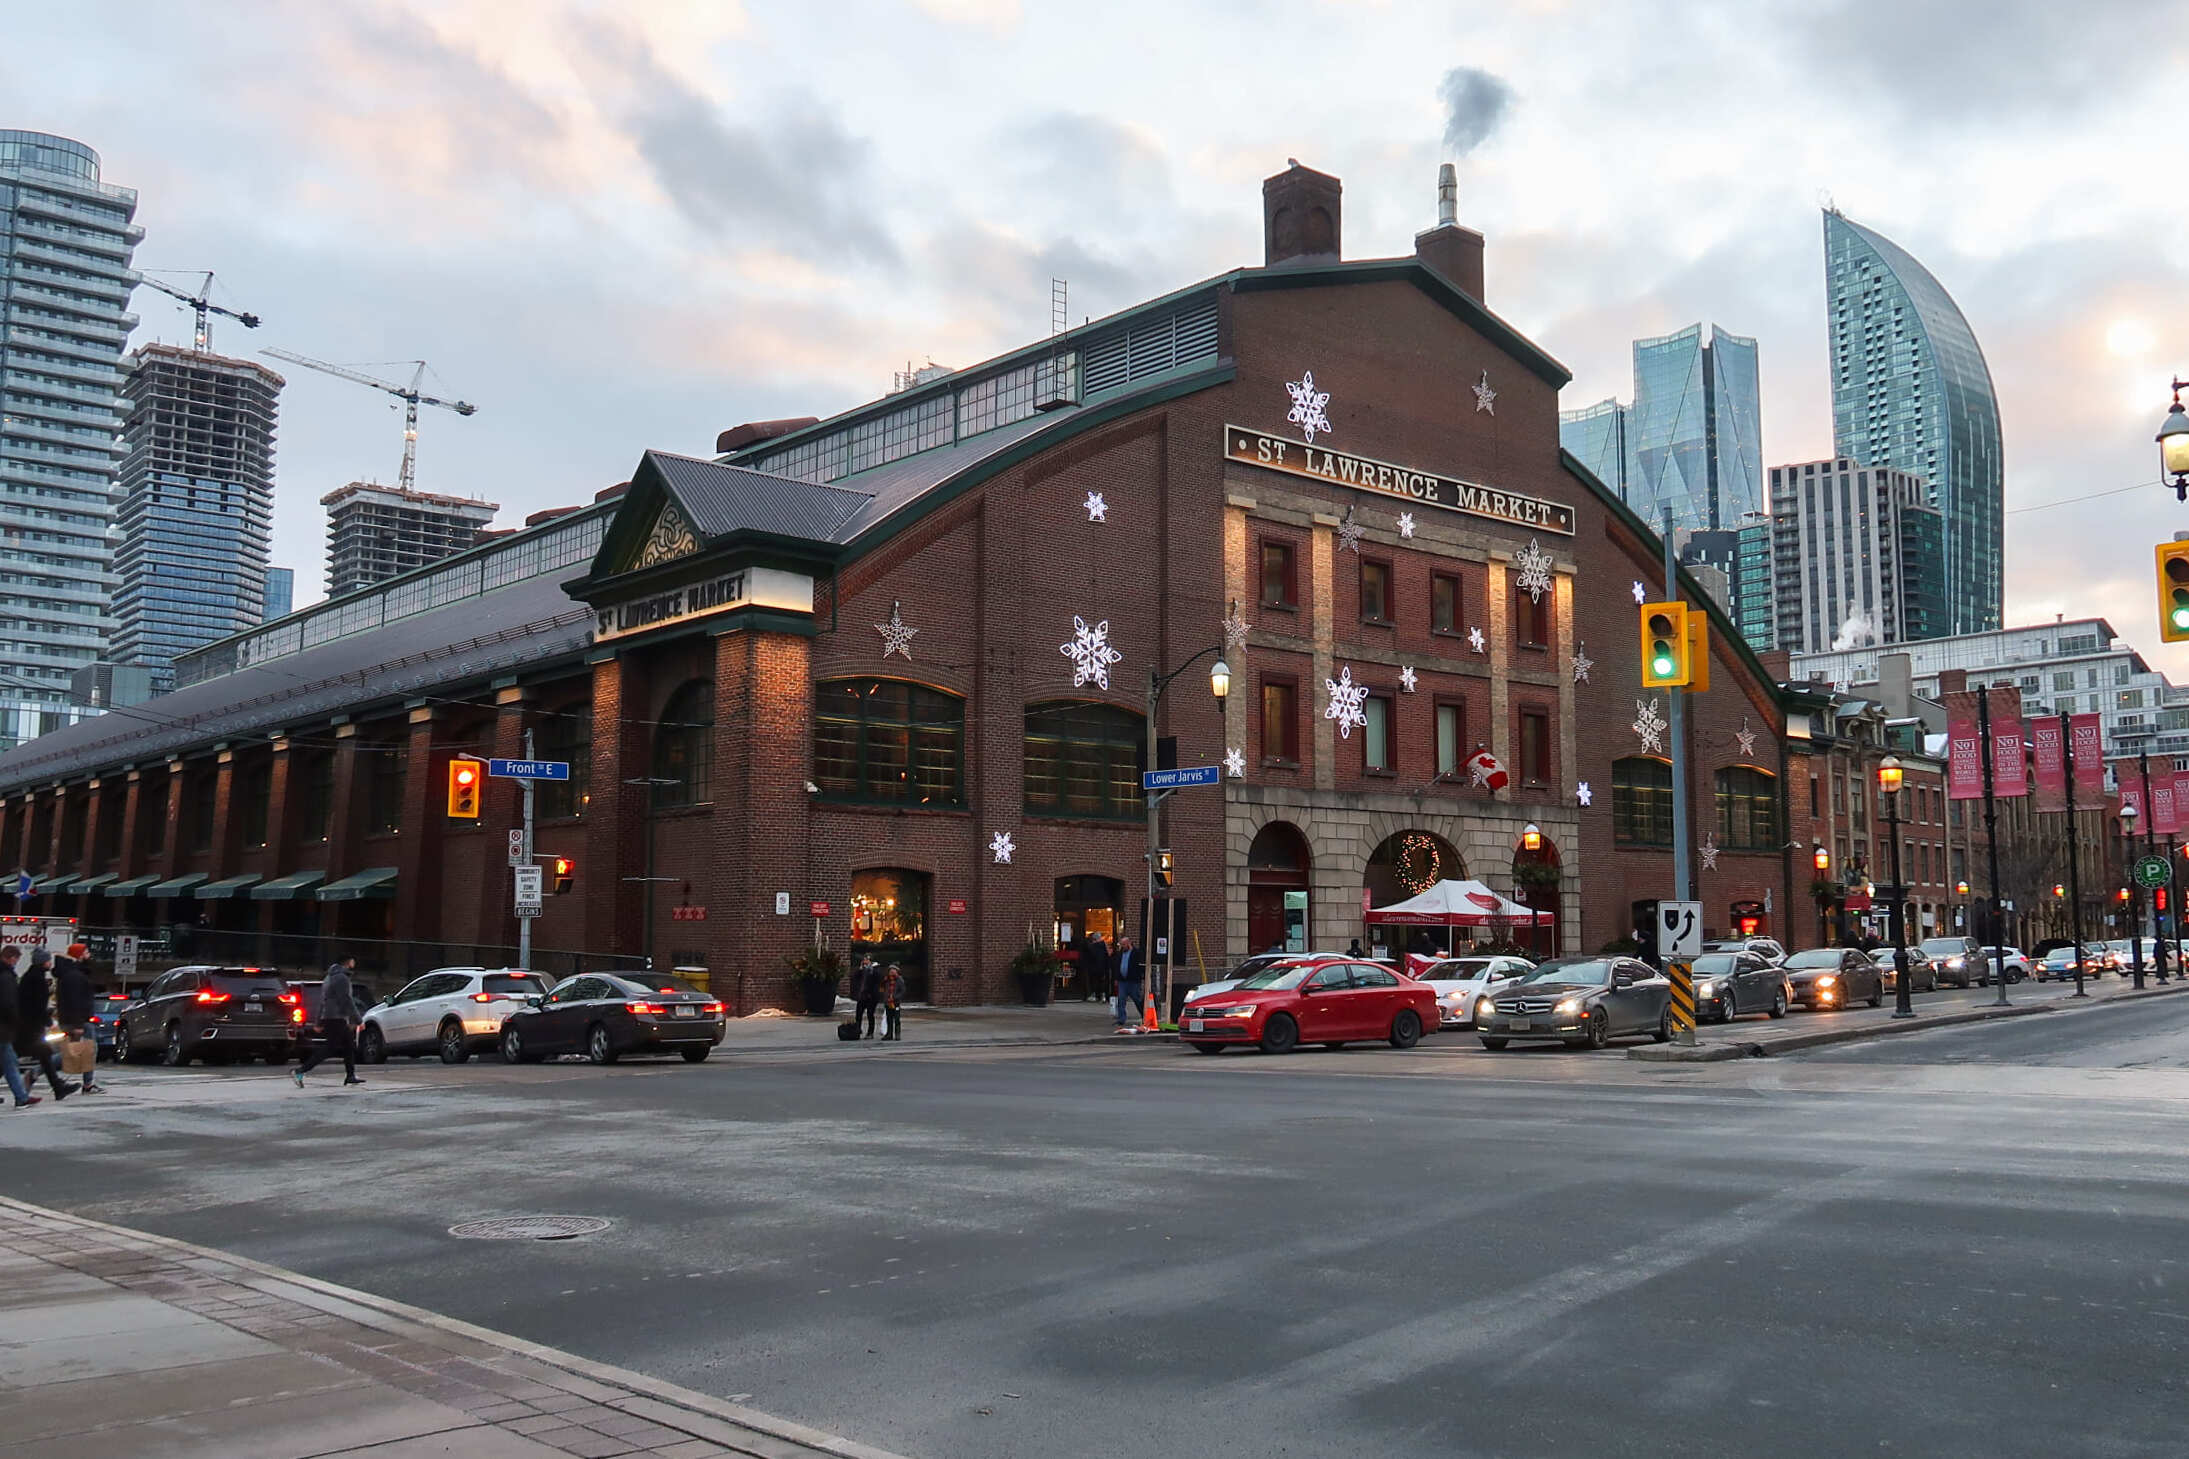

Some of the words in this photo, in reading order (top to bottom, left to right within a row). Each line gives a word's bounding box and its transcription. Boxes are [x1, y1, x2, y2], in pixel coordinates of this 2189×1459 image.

[1305, 449, 1438, 500] LAWRENCE
[1457, 485, 1550, 525] MARKET
[617, 592, 682, 631] LAWRENCE
[688, 572, 745, 613] MARKET
[506, 761, 535, 774] Front
[546, 764, 553, 775] E
[1152, 773, 1176, 784] Lower
[1178, 771, 1203, 783] Jarvis
[2145, 864, 2160, 877] P
[517, 907, 540, 916] BEGINS
